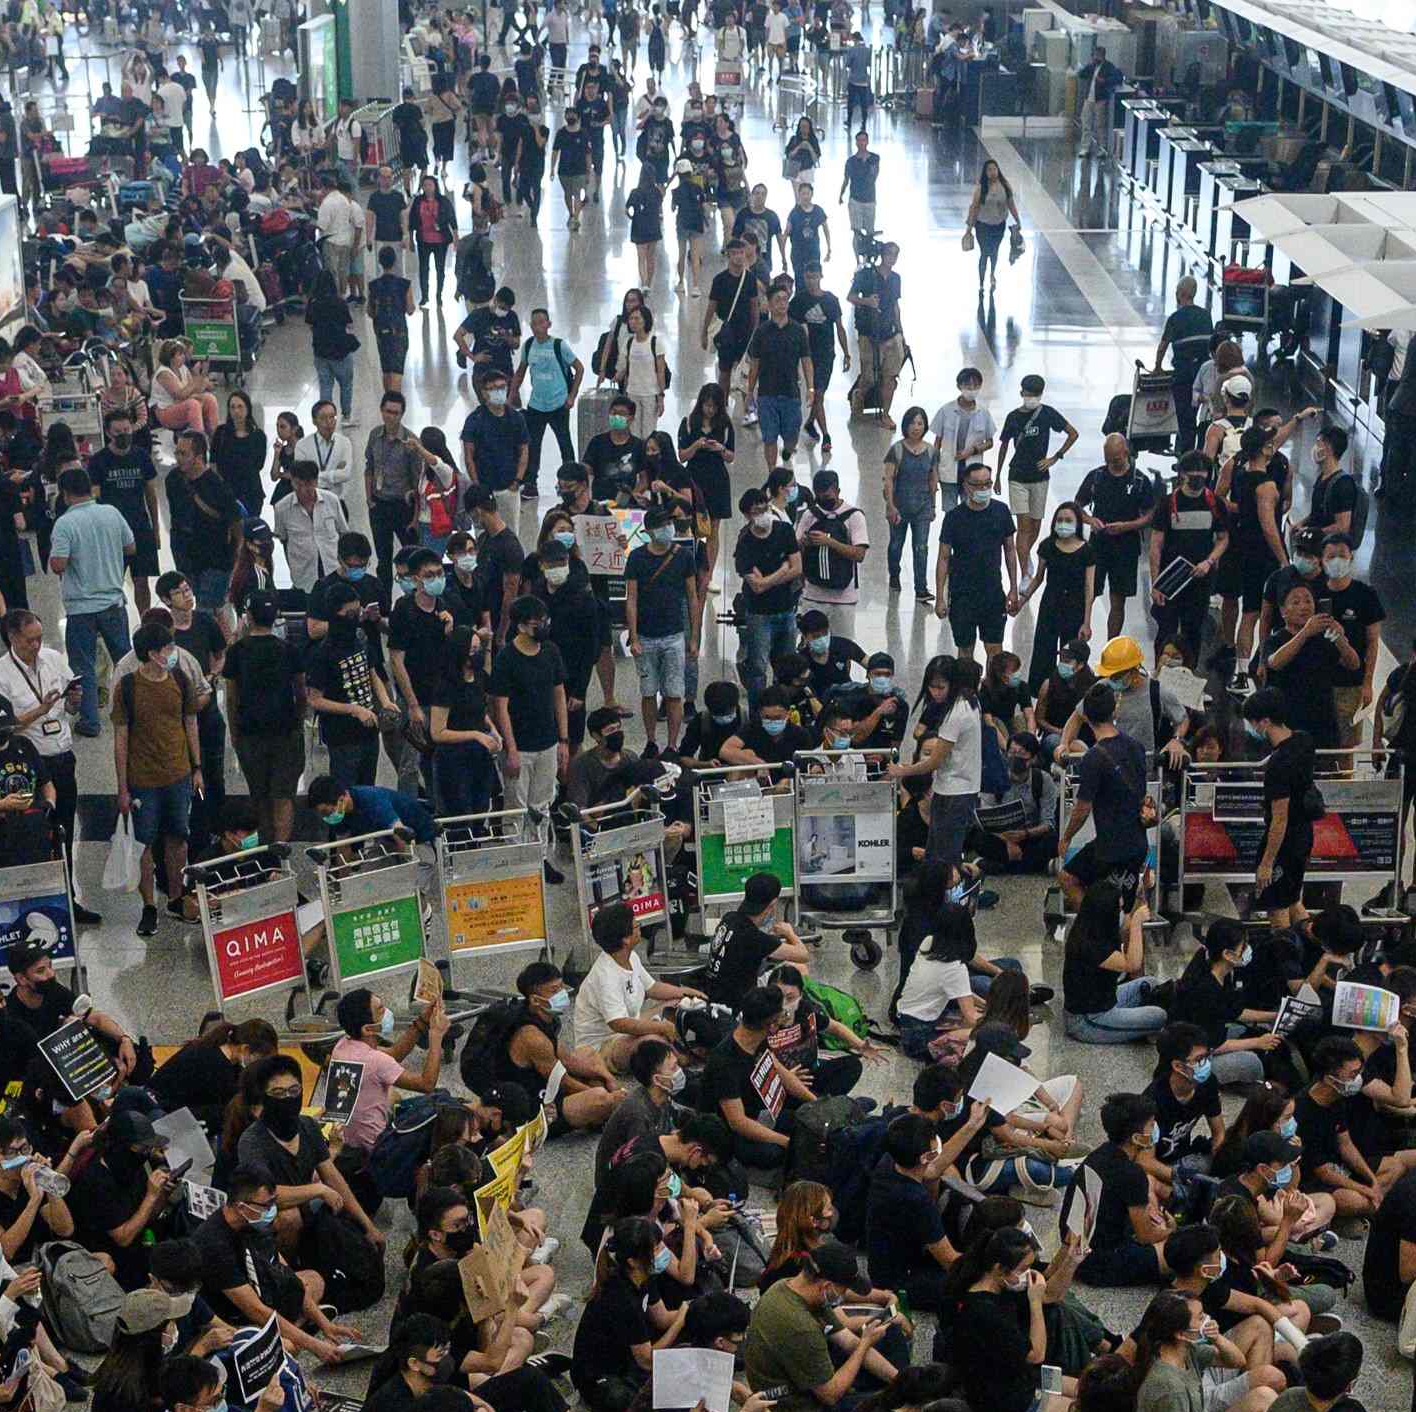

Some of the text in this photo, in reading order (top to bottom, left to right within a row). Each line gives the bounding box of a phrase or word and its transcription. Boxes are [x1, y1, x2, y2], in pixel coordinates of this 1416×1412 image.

[858, 839, 889, 848] KOHLER
[633, 899, 660, 913] QIMA
[226, 928, 284, 958] QIMA
[51, 1038, 73, 1054] WHY
